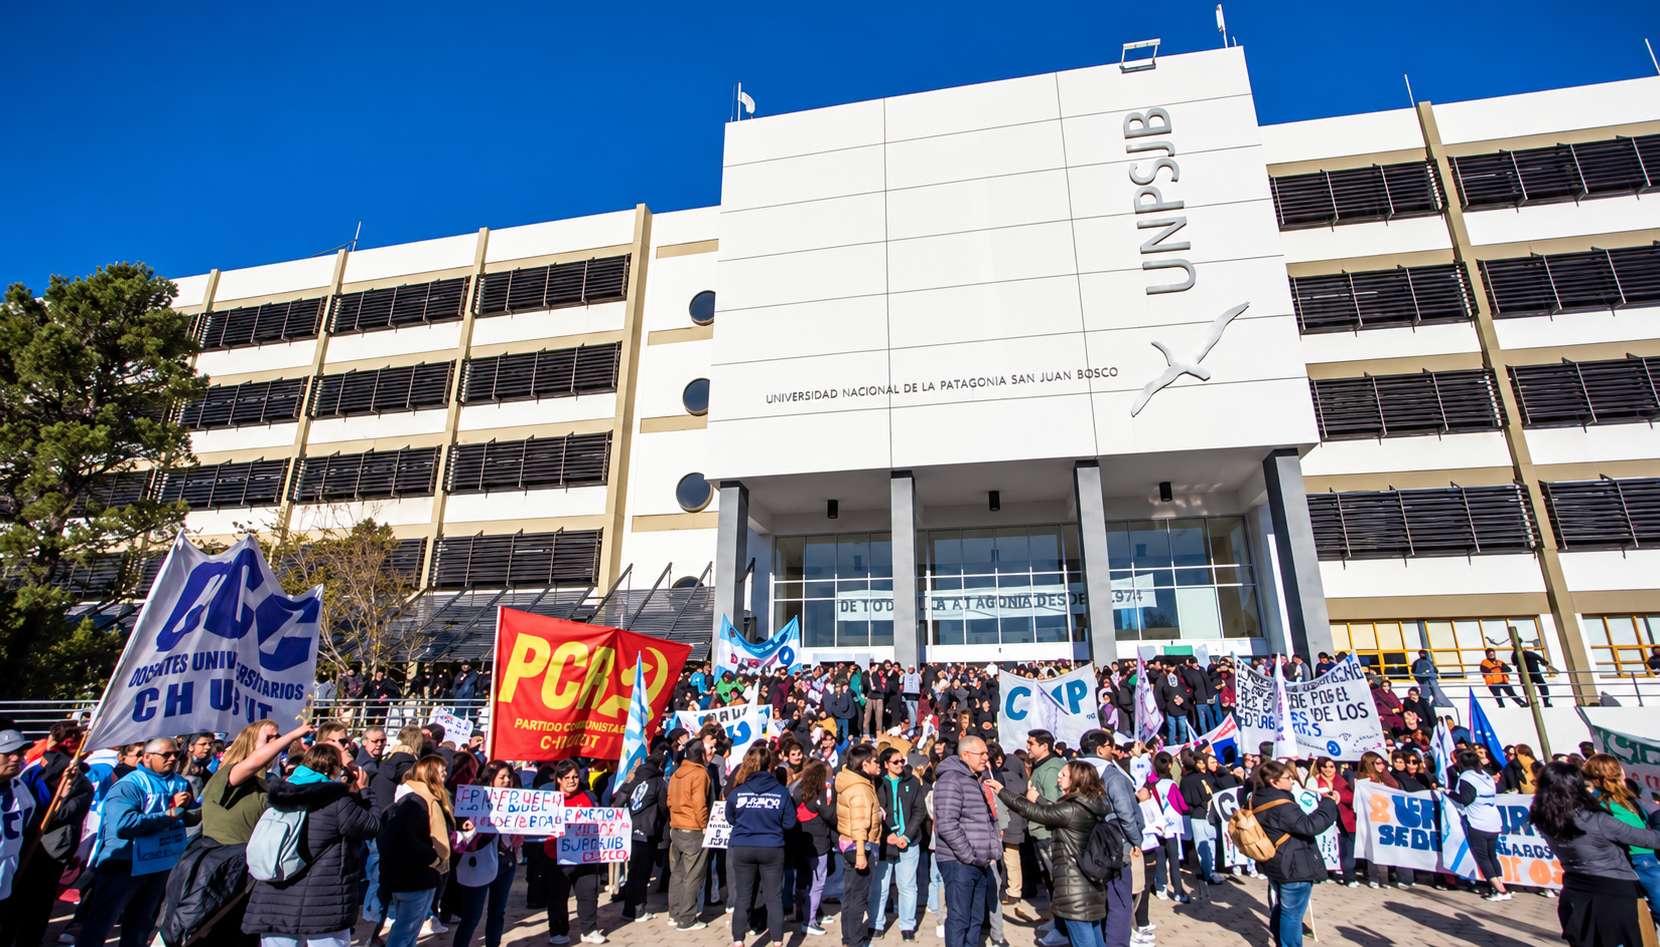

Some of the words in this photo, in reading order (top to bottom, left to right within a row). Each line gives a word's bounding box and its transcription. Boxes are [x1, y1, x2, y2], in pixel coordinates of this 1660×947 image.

[1123, 107, 1197, 295] UNPSJB
[766, 388, 838, 404] UNIVERSIDAD
[842, 384, 900, 398] NACIONAL
[903, 382, 918, 393] DE
[922, 381, 936, 392] LA
[940, 375, 1007, 391] PATAGONIA
[1011, 373, 1035, 385] SAN
[1040, 370, 1072, 383] JUAN
[1077, 366, 1119, 380] BOSCO
[840, 600, 857, 613] DE
[498, 632, 616, 710] PCR
[514, 717, 562, 733] PARTIDO
[1336, 702, 1369, 721] LOS
